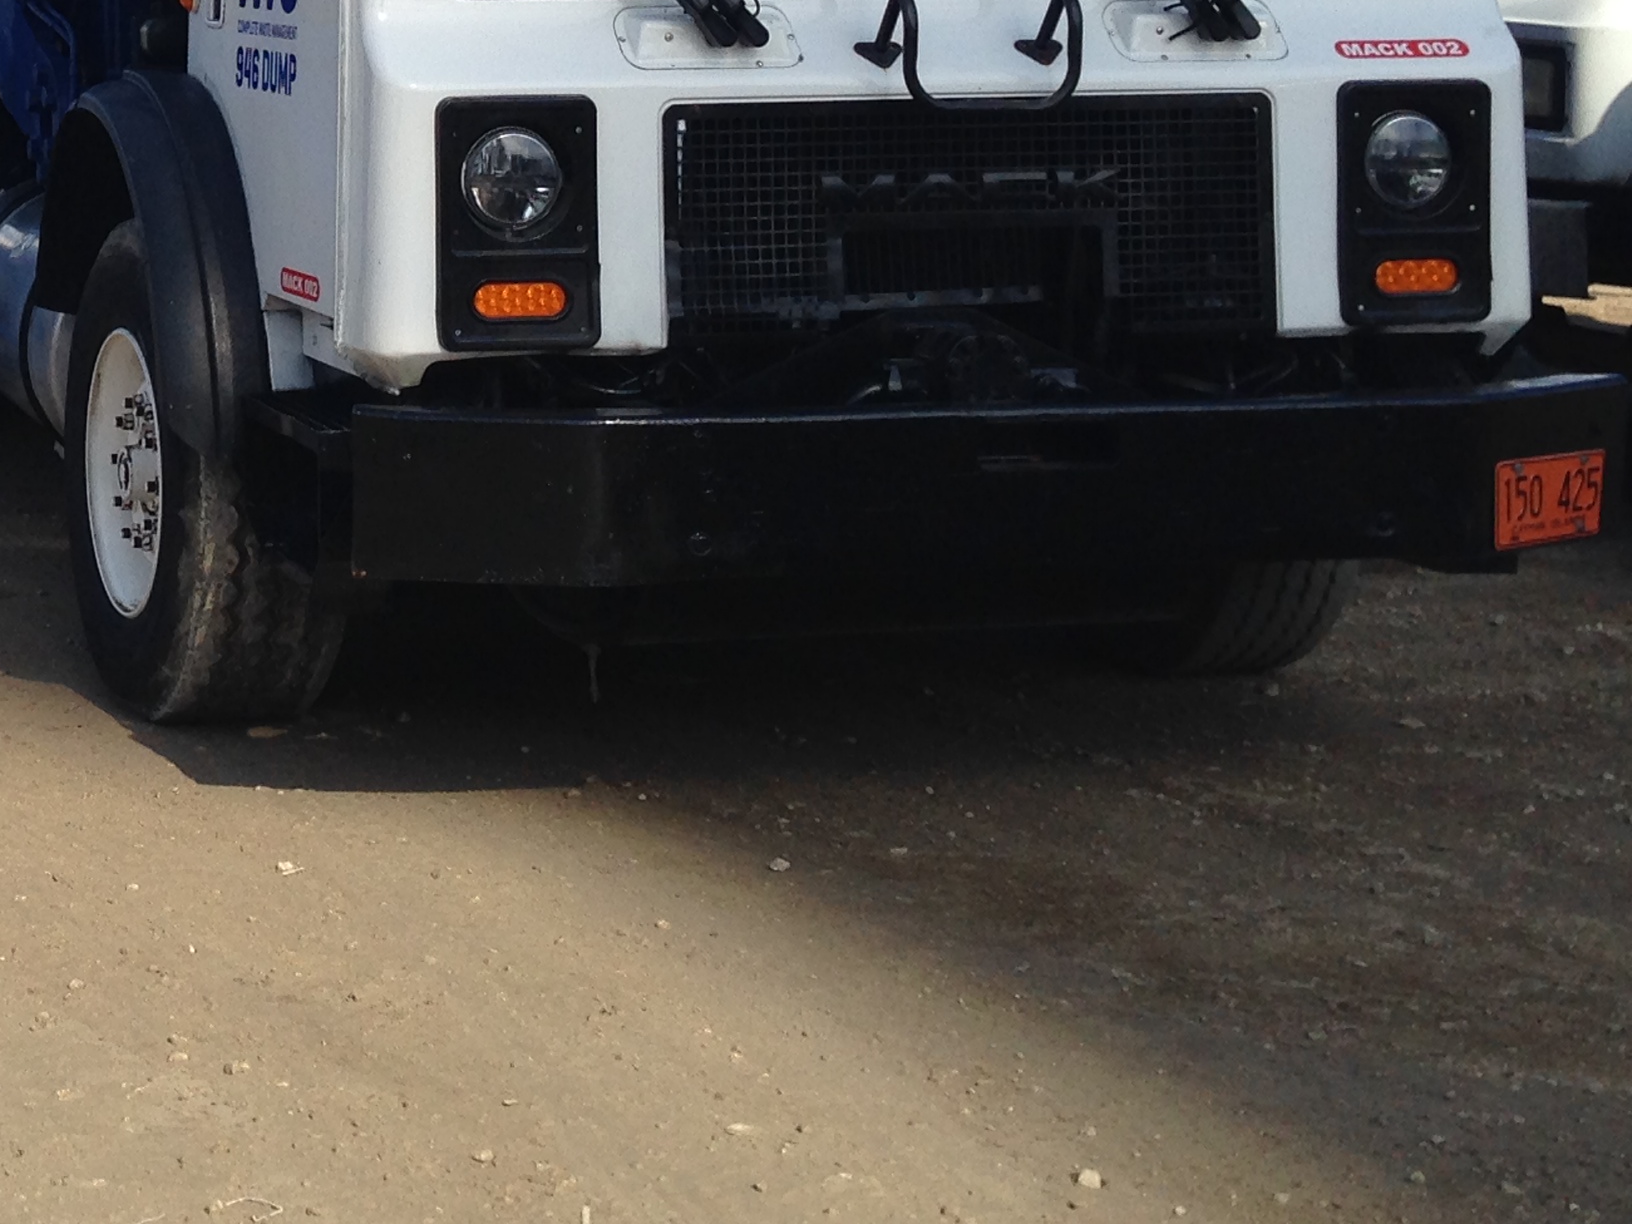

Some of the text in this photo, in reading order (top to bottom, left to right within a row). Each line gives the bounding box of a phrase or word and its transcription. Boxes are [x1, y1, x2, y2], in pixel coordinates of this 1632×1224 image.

[235, 46, 297, 97] 946 DUMP
[1340, 41, 1464, 57] MACK 002
[1504, 467, 1600, 523] 150 425
